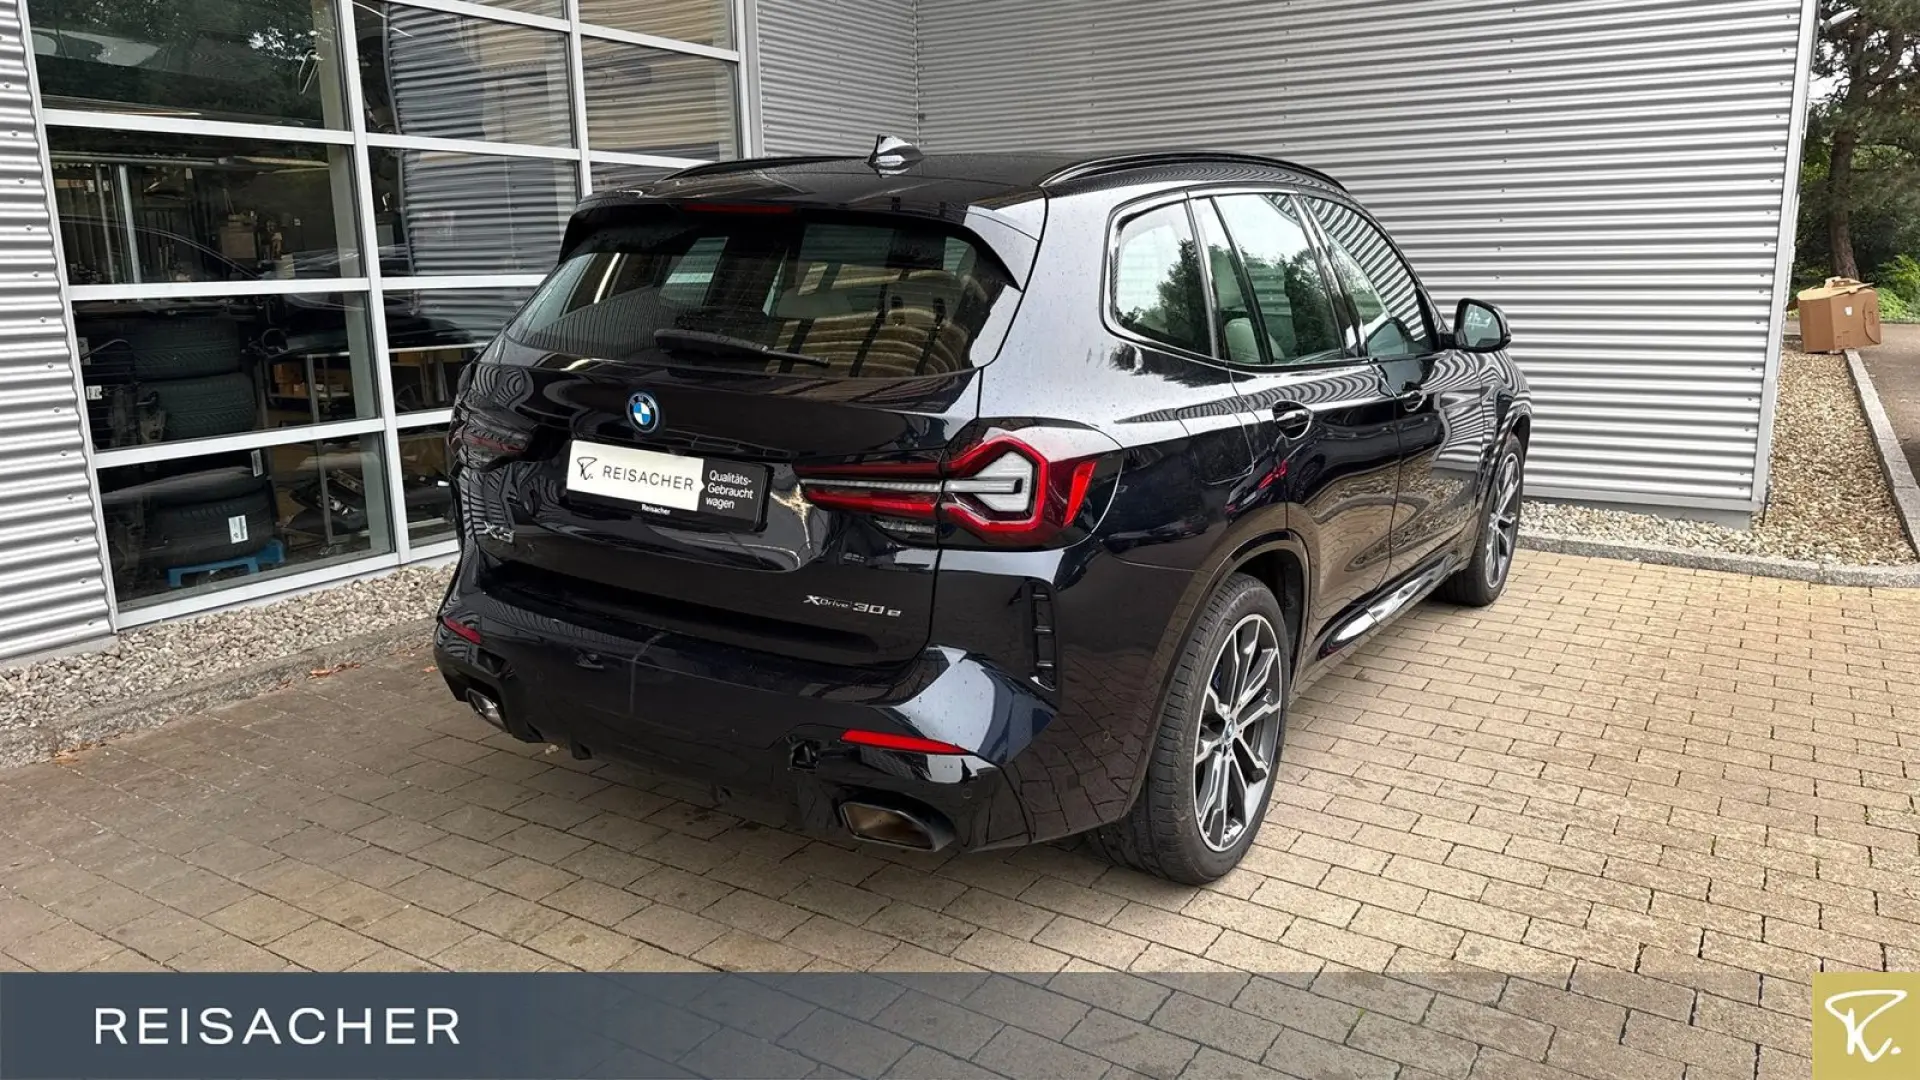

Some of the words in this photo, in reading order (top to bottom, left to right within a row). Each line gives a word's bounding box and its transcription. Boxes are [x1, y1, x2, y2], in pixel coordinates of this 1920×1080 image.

[602, 465, 694, 492] REISACHER
[709, 469, 752, 486] Qualitäts-
[707, 482, 754, 500] Gebraucht
[641, 503, 671, 516] Reisacher
[705, 497, 735, 510] wagen
